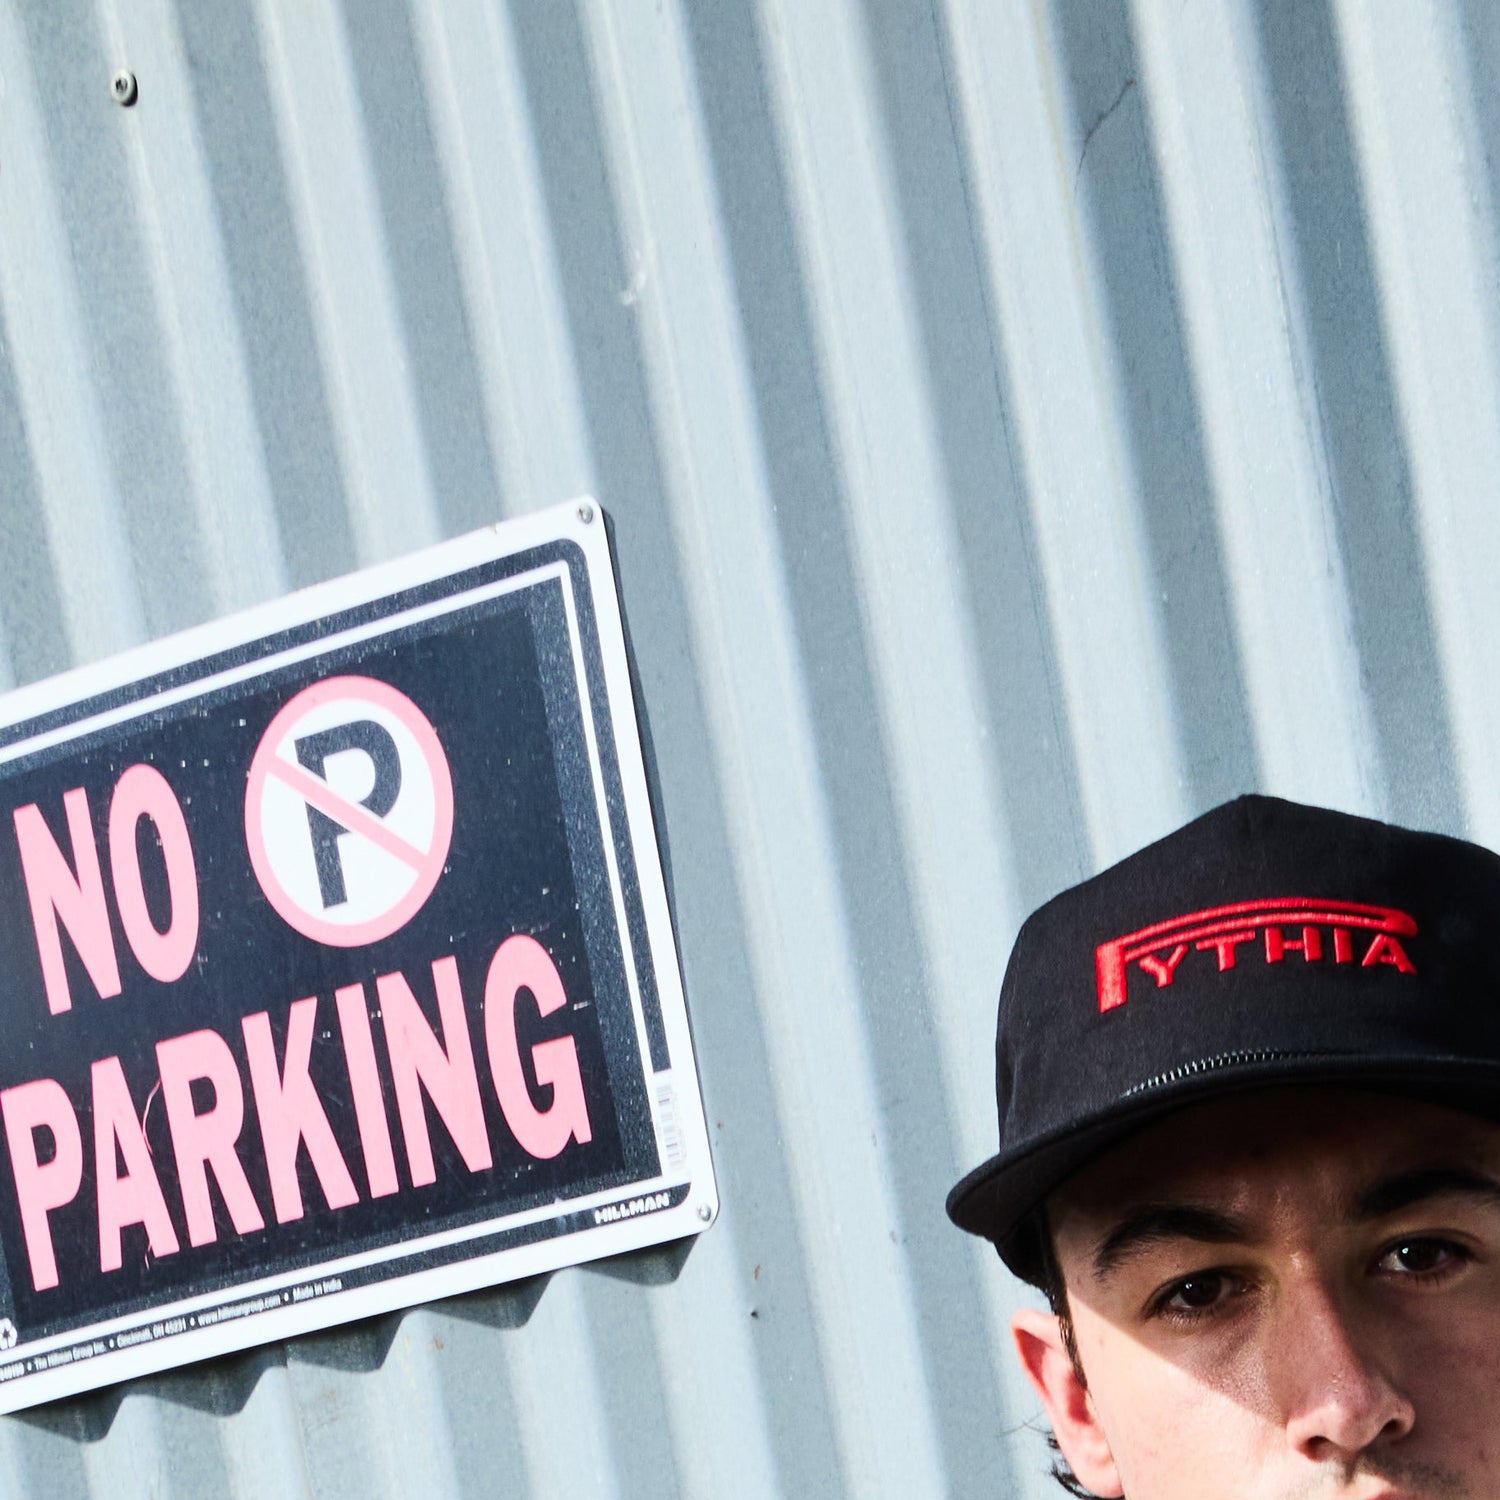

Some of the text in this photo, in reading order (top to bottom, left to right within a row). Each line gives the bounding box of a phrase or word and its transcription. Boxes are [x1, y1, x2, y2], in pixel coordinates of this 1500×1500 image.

[14, 764, 199, 1014] NO
[1096, 898, 1417, 1013] PYTHIA
[0, 935, 592, 1291] PARKING
[595, 1193, 670, 1224] HILLMAN
